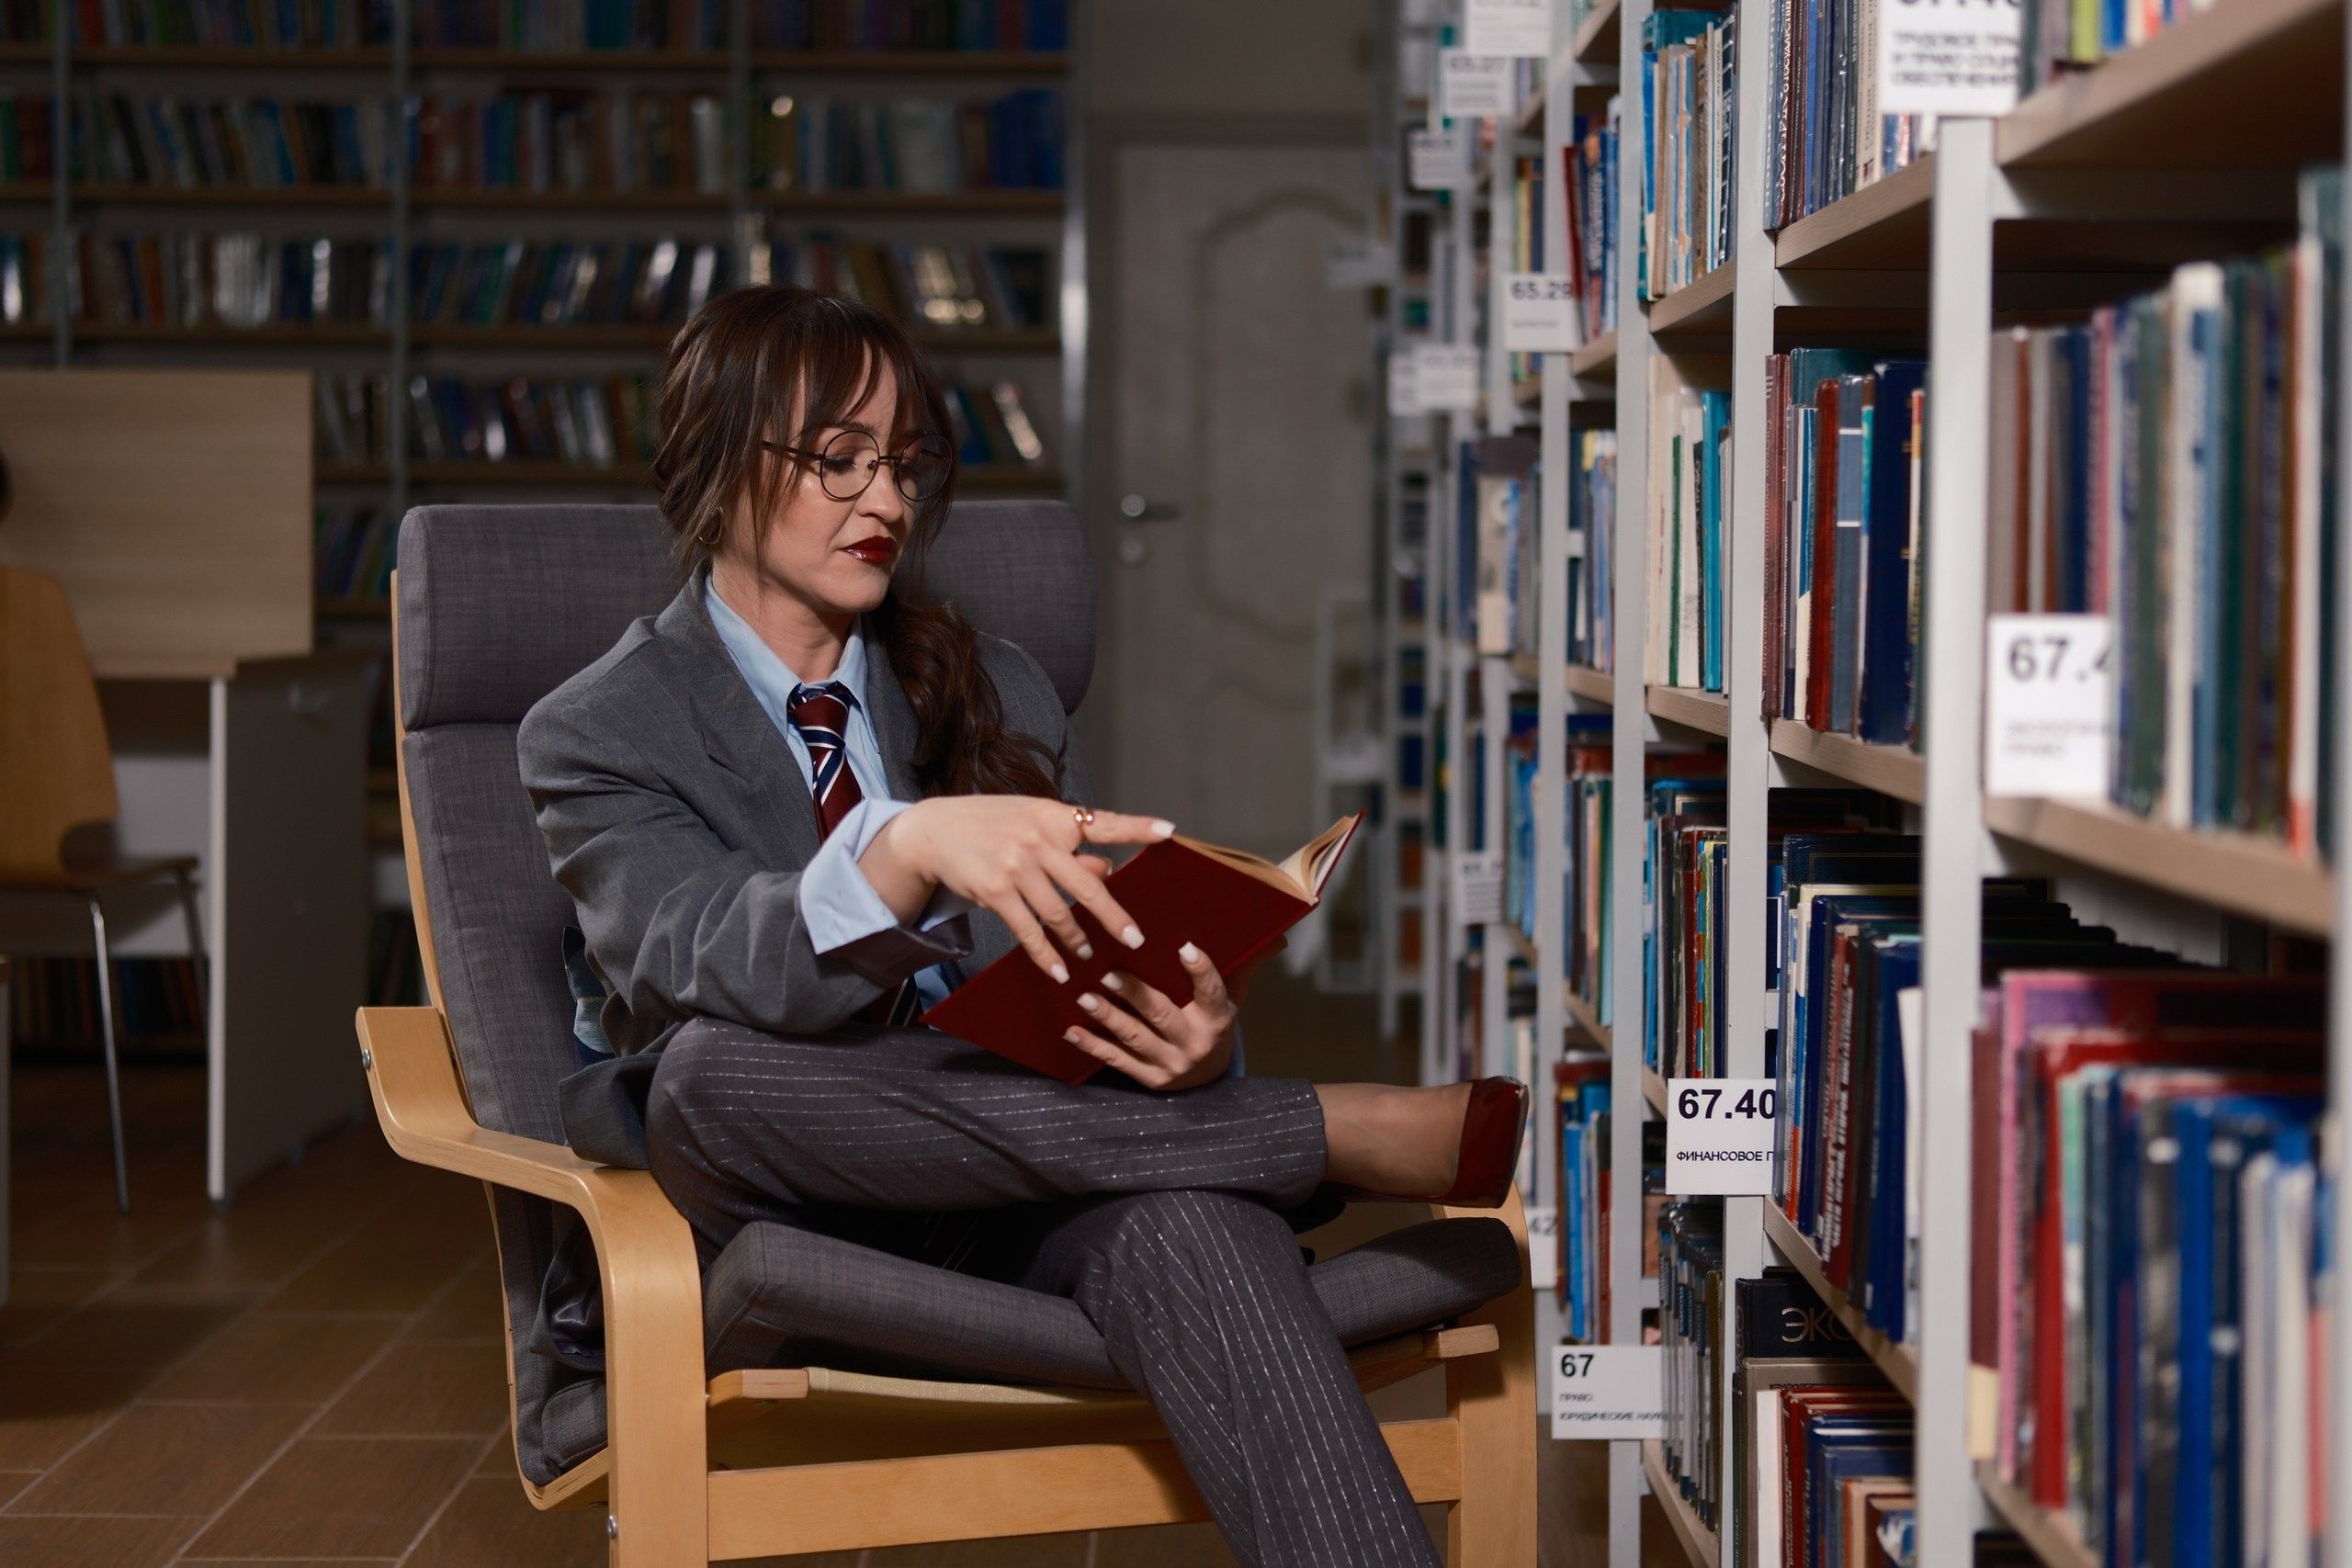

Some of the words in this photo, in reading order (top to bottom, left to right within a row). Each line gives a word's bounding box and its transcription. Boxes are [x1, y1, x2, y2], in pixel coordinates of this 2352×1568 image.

[1765, 113, 1773, 208] НОВЫЙ
[1678, 1089, 1776, 1119] 67.40
[1676, 1151, 1763, 1161] ФИНАНСОВОЕ
[1560, 1353, 1594, 1377] 67
[1559, 1393, 1594, 1402] ПРАВО
[1559, 1412, 1634, 1421] ЮРИДИЧЕСКИЕ
